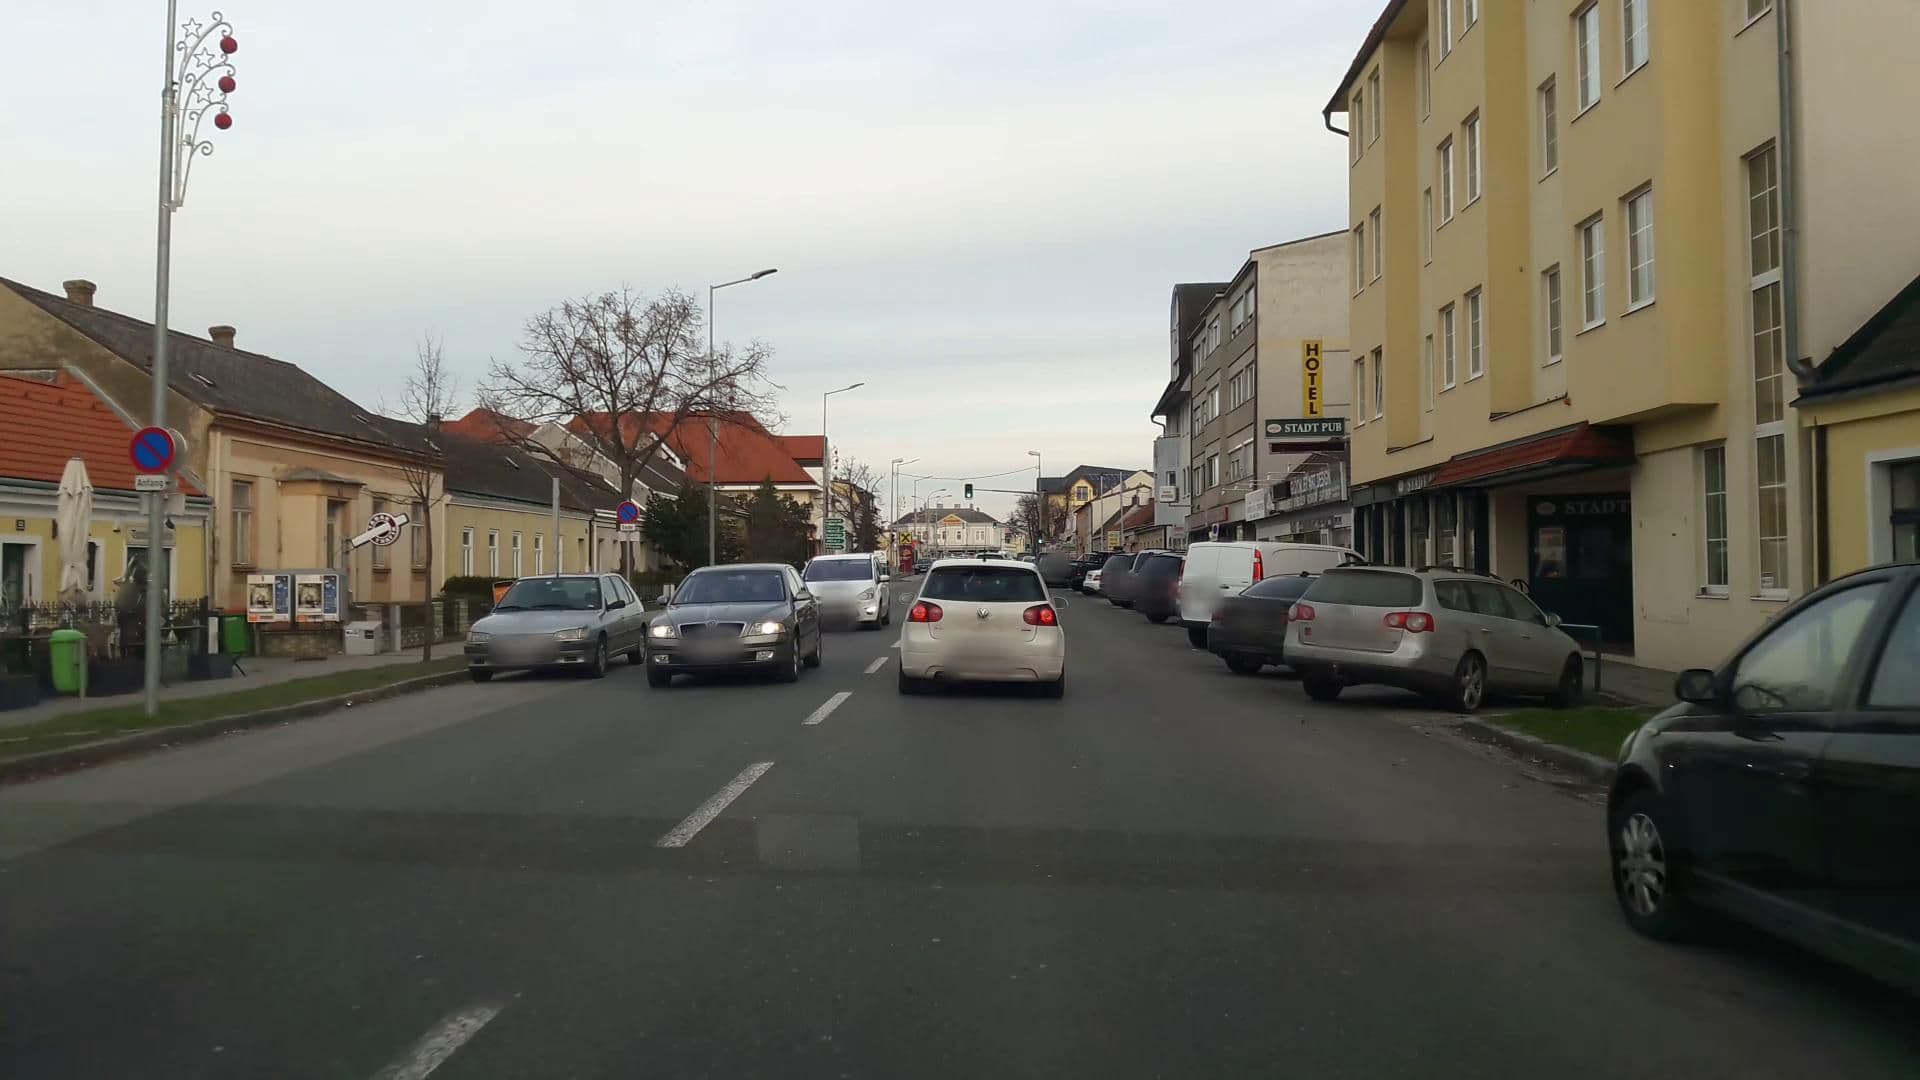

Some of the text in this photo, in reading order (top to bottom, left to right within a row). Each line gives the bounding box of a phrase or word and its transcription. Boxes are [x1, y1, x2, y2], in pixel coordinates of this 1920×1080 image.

[1305, 343, 1320, 415] HOTEL
[1284, 423, 1319, 433] STADT
[1321, 422, 1342, 432] PUB
[137, 479, 165, 489] Anfang
[1565, 500, 1631, 514] STADT
